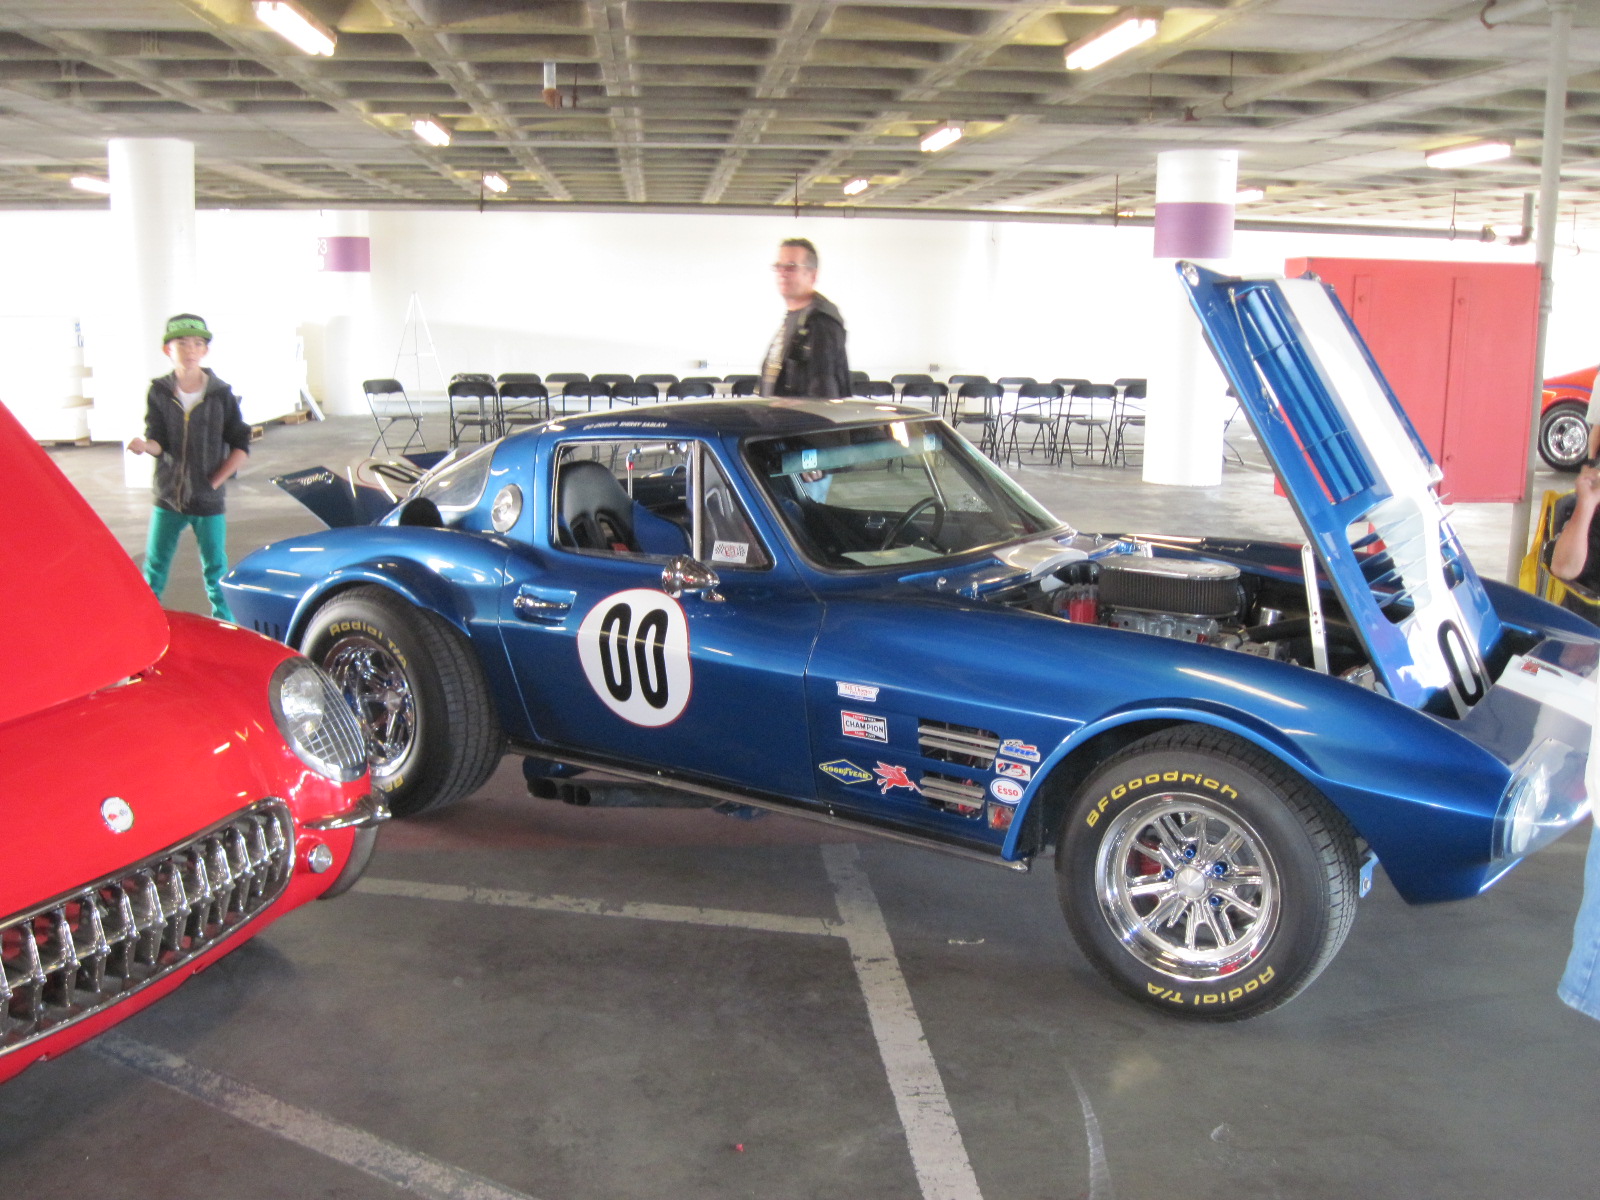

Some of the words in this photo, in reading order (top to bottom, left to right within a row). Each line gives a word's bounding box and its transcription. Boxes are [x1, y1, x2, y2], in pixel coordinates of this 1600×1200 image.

[329, 621, 383, 637] Radial
[599, 602, 669, 709] 00
[845, 719, 885, 734] CHAMPION
[823, 765, 869, 779] GOODYEAR
[1086, 770, 1239, 828] BFGoodrich
[1147, 982, 1184, 1004] T/A
[1194, 965, 1276, 1006] Radial
